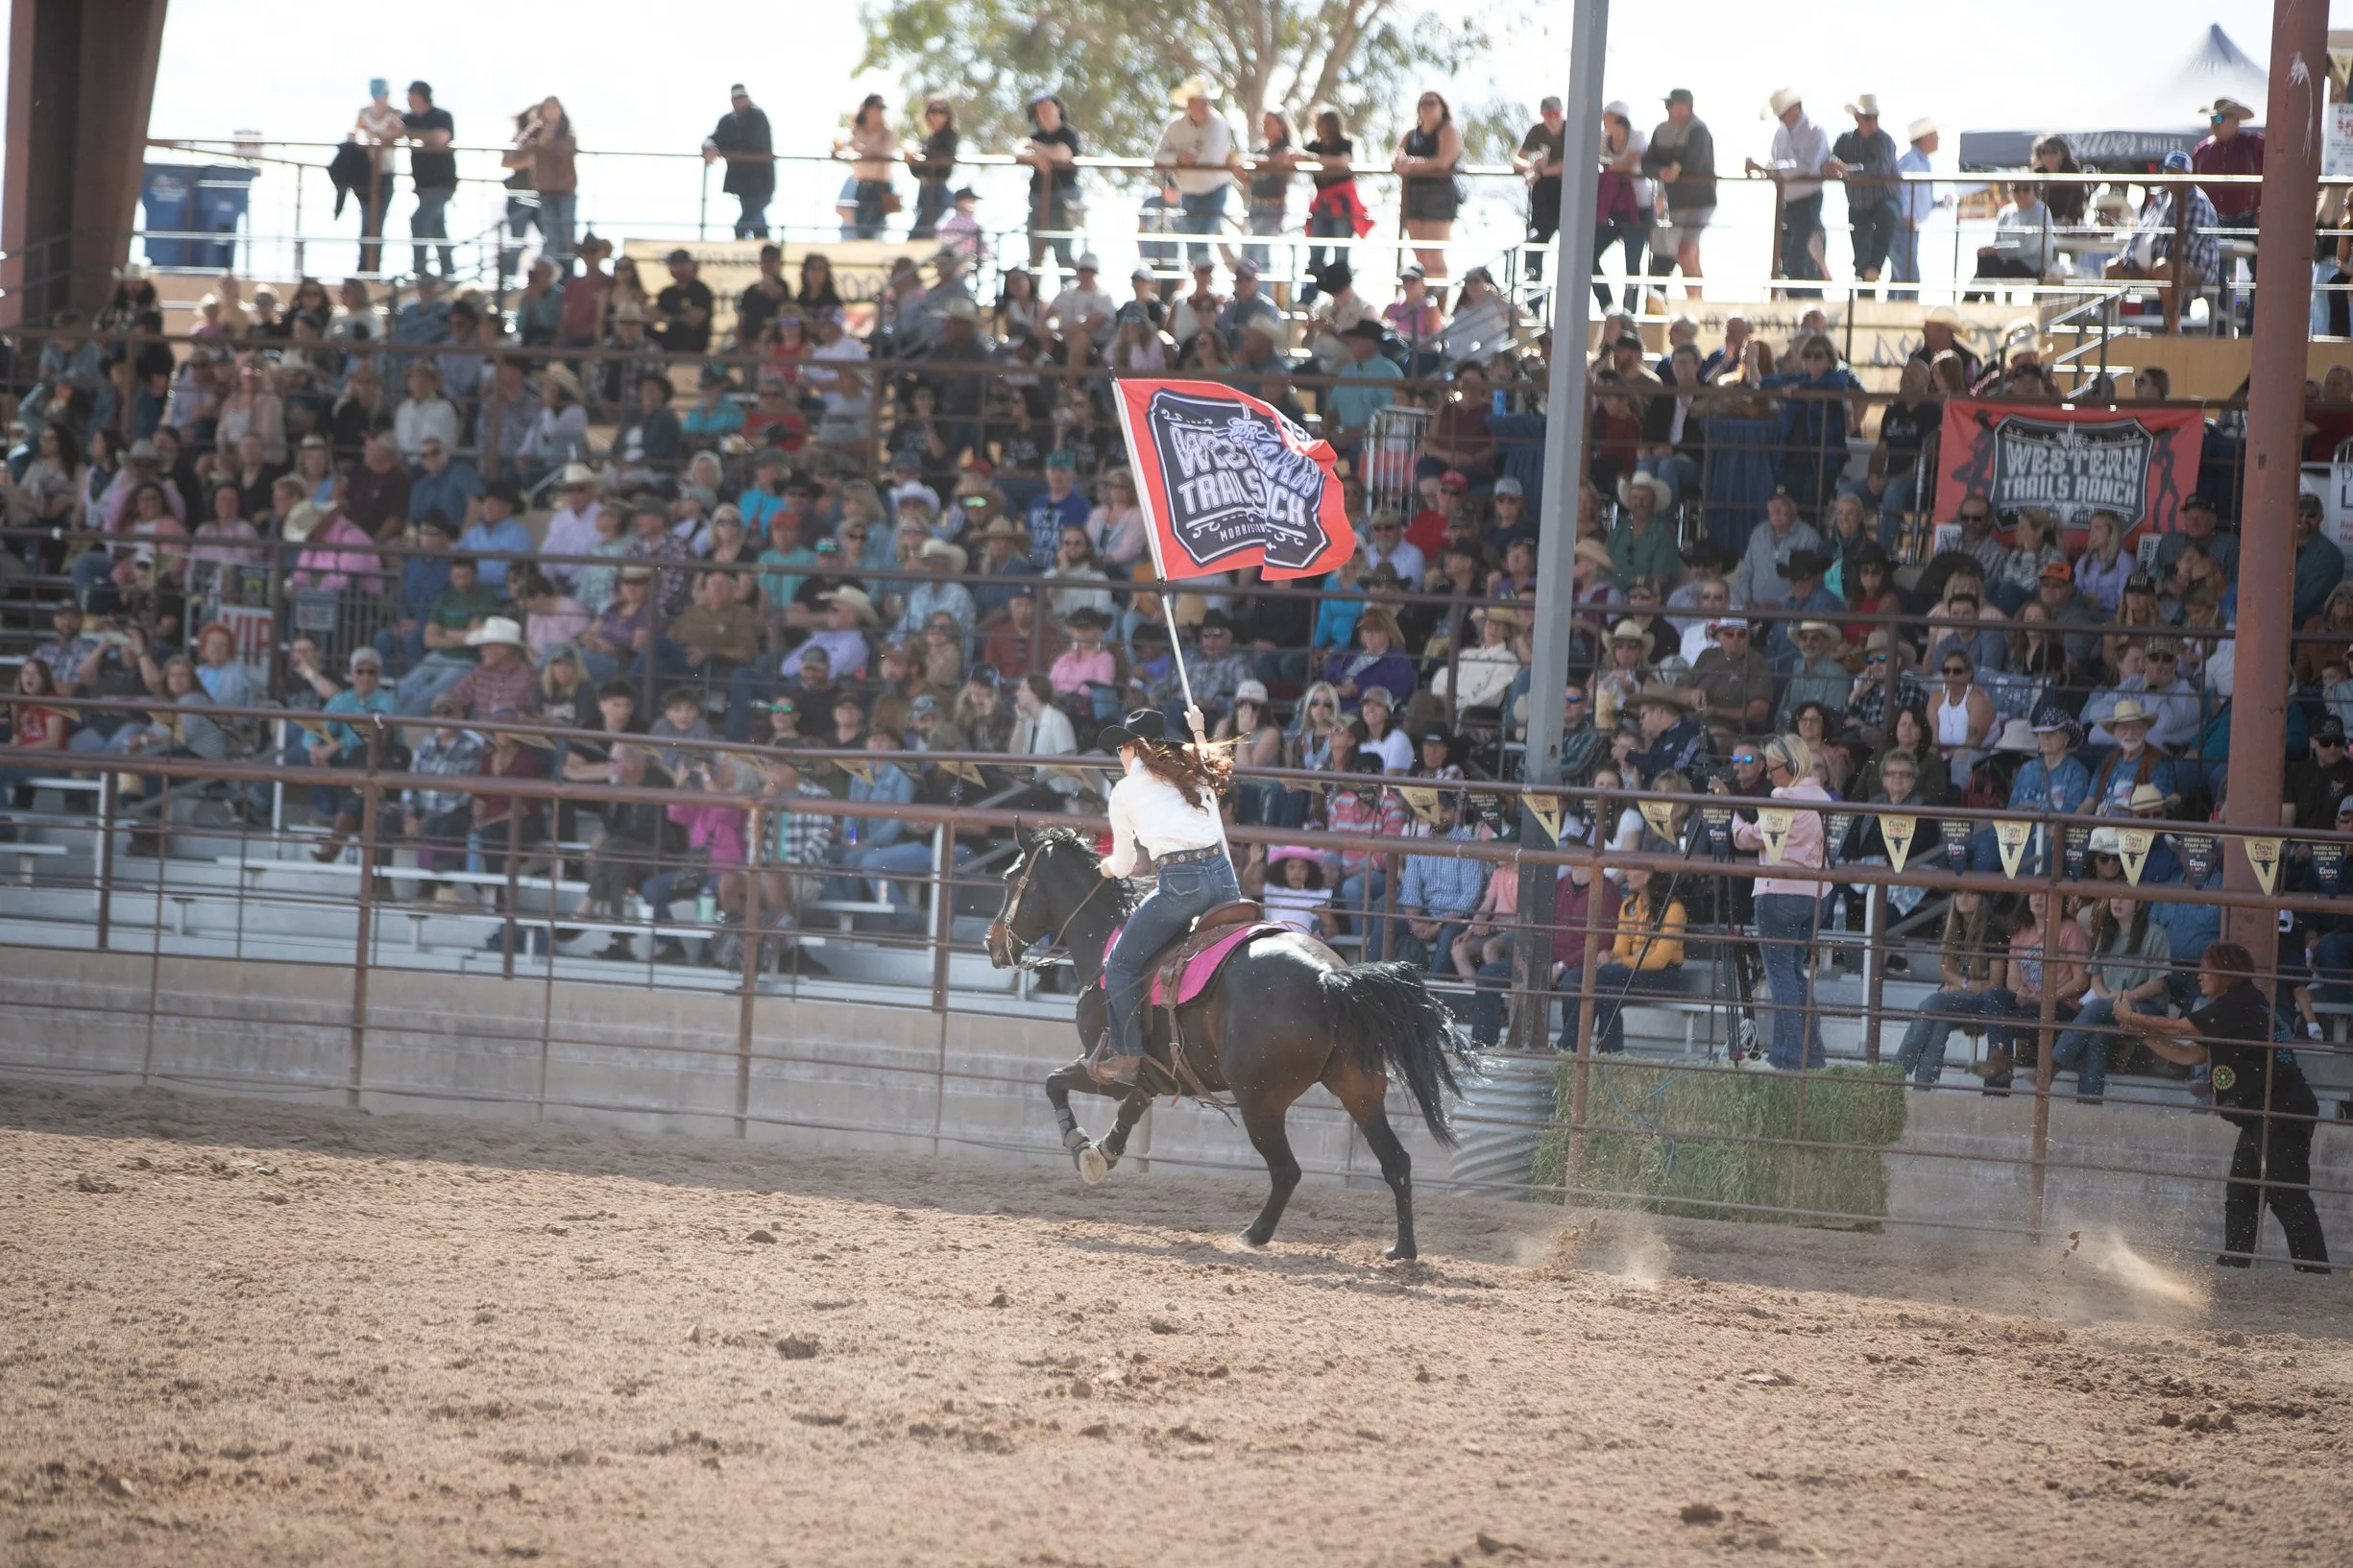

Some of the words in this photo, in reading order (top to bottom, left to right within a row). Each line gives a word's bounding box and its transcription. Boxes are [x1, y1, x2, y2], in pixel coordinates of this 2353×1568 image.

[2067, 132, 2137, 157] Silver
[2142, 136, 2183, 153] BULLET
[2005, 441, 2142, 481] WESTERN
[1177, 468, 1267, 515] TRAILS
[2002, 475, 2071, 500] TRAILS
[2074, 478, 2138, 505] RANCH
[222, 612, 273, 664] VIP
[1948, 842, 1966, 852] Coors
[2066, 849, 2083, 857] Coors
[2190, 858, 2207, 867] Coors
[2318, 866, 2338, 875] Coors
